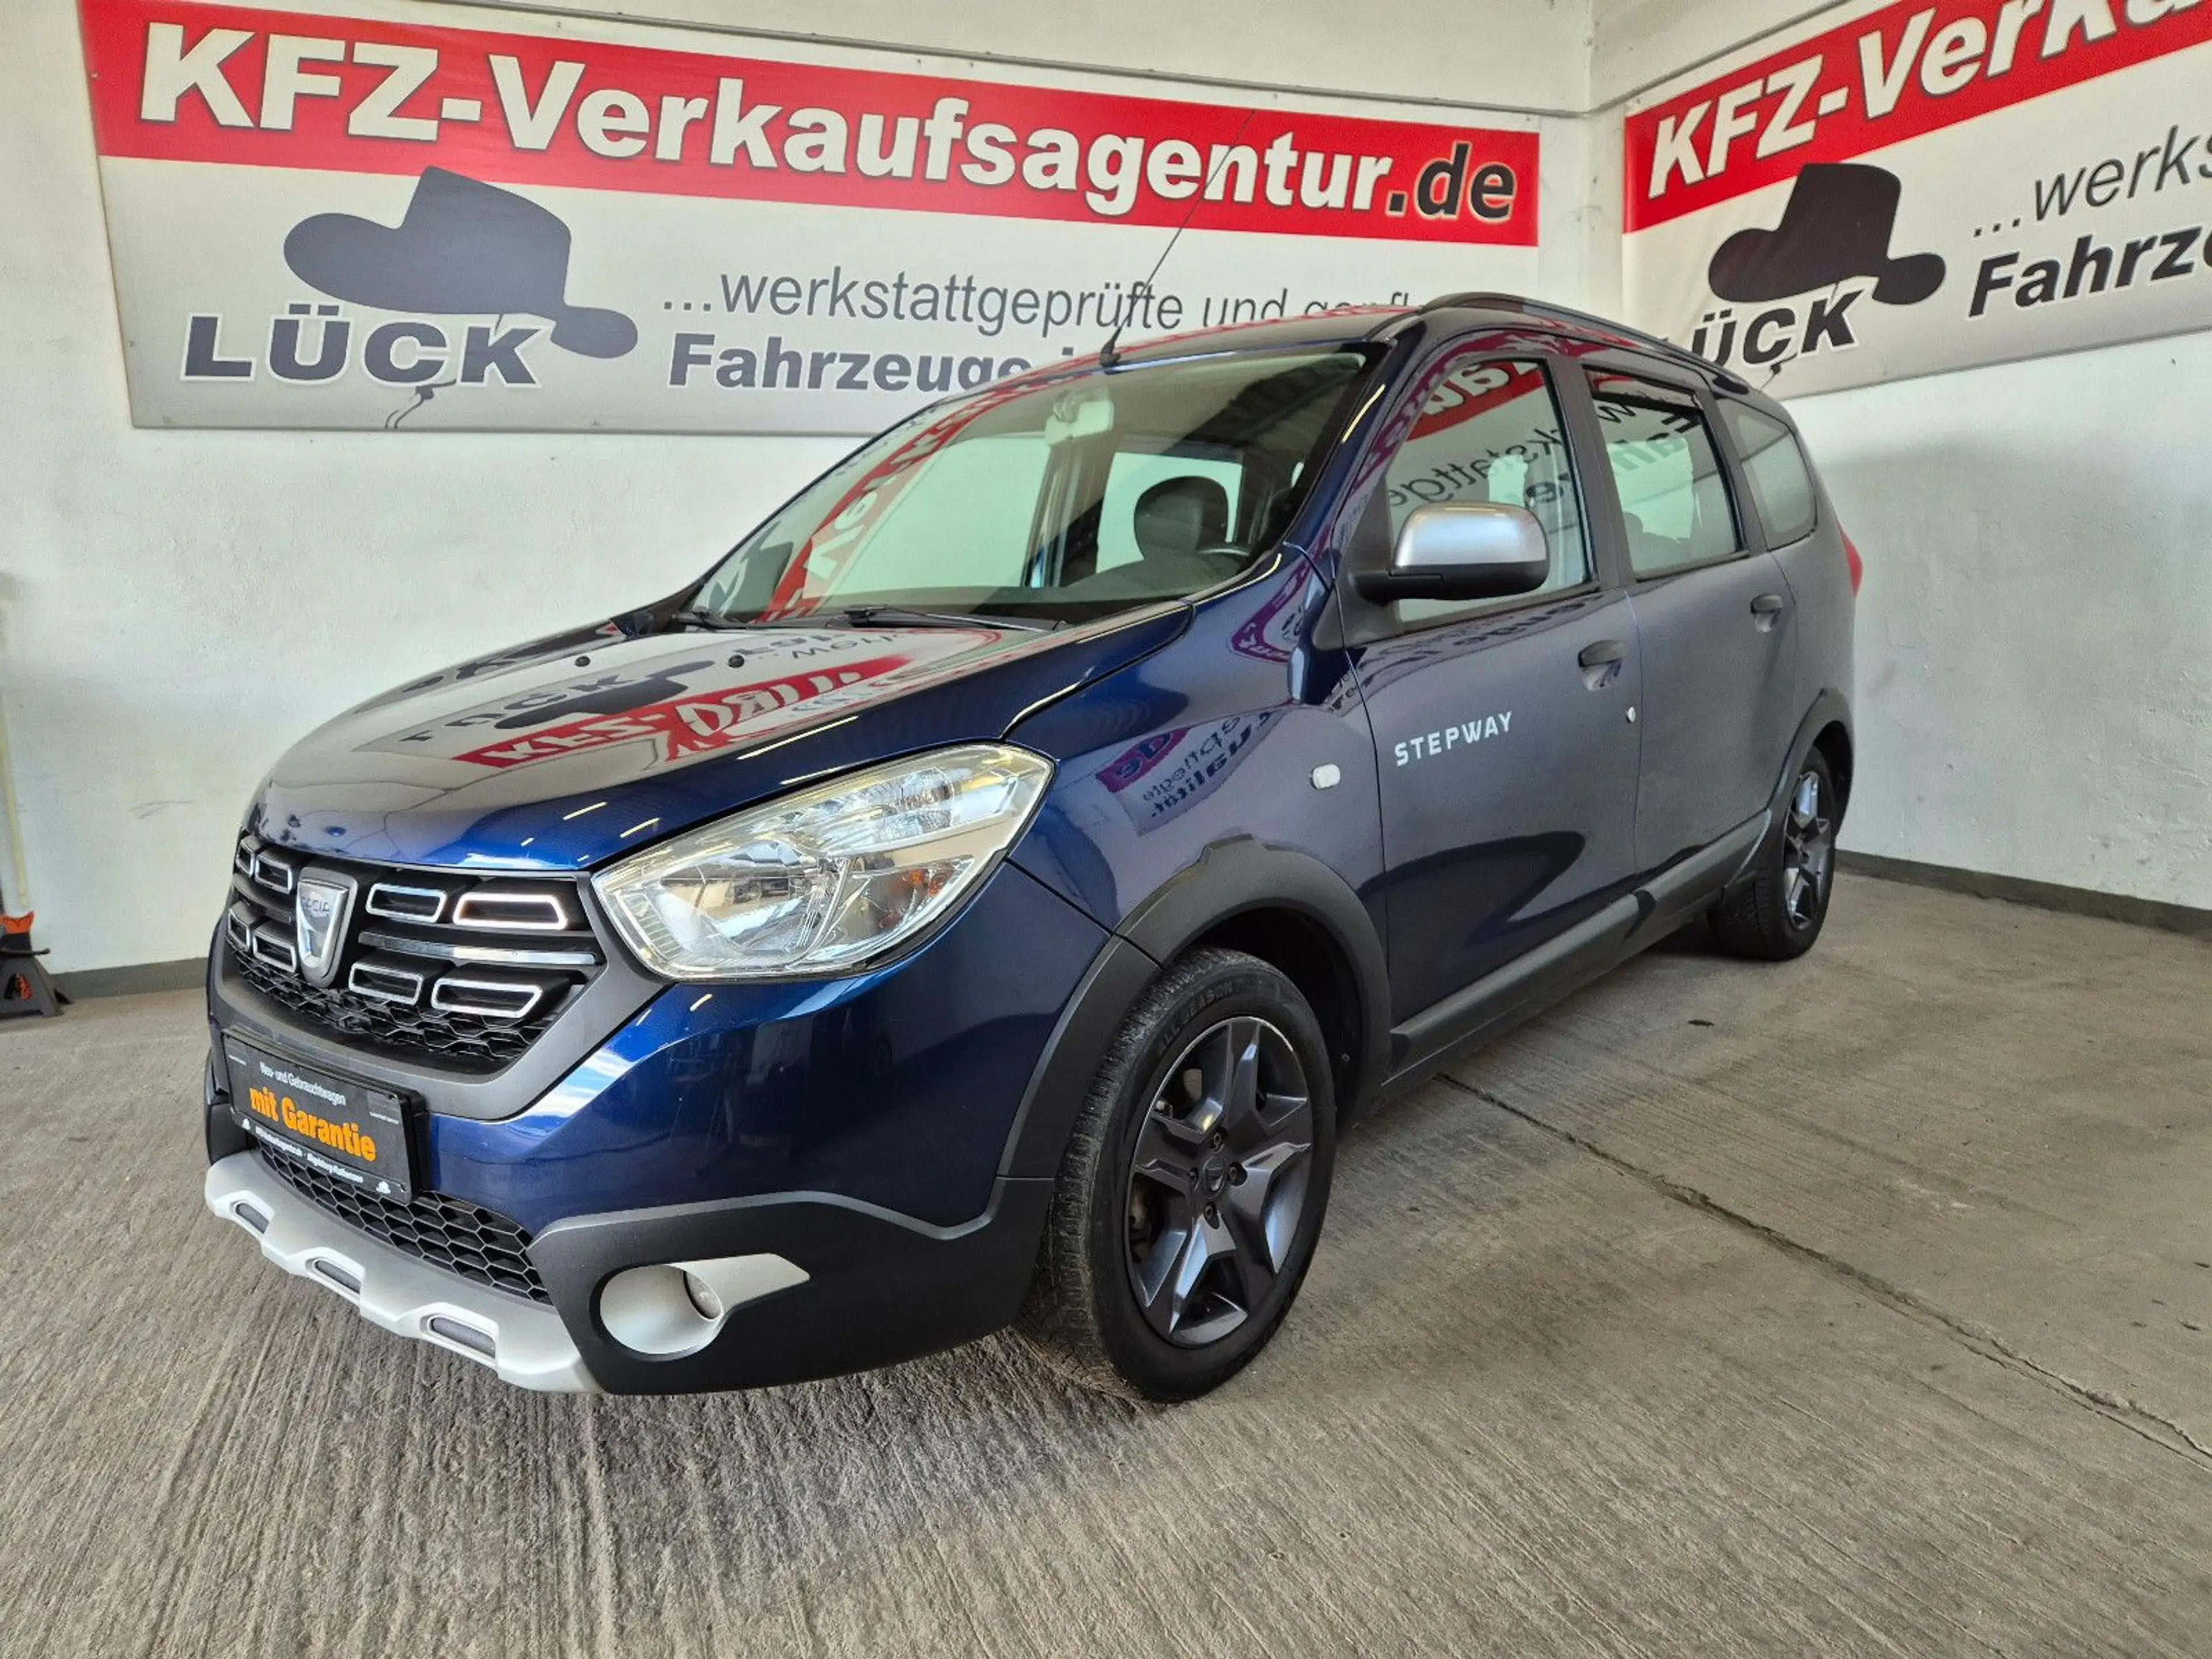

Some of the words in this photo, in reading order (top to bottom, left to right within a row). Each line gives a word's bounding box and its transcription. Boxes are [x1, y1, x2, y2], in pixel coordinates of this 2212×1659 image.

[140, 22, 1517, 224] KFZ-Verkaufsagentur.de
[663, 267, 1183, 338] ...werkstattgeprüfte
[1202, 287, 1289, 327] und
[1692, 289, 1865, 366] ÜCK
[183, 302, 540, 387] LÜCK
[1394, 711, 1512, 767] STEPWAY
[249, 1086, 279, 1123] mit
[282, 1096, 377, 1162] Garantie
